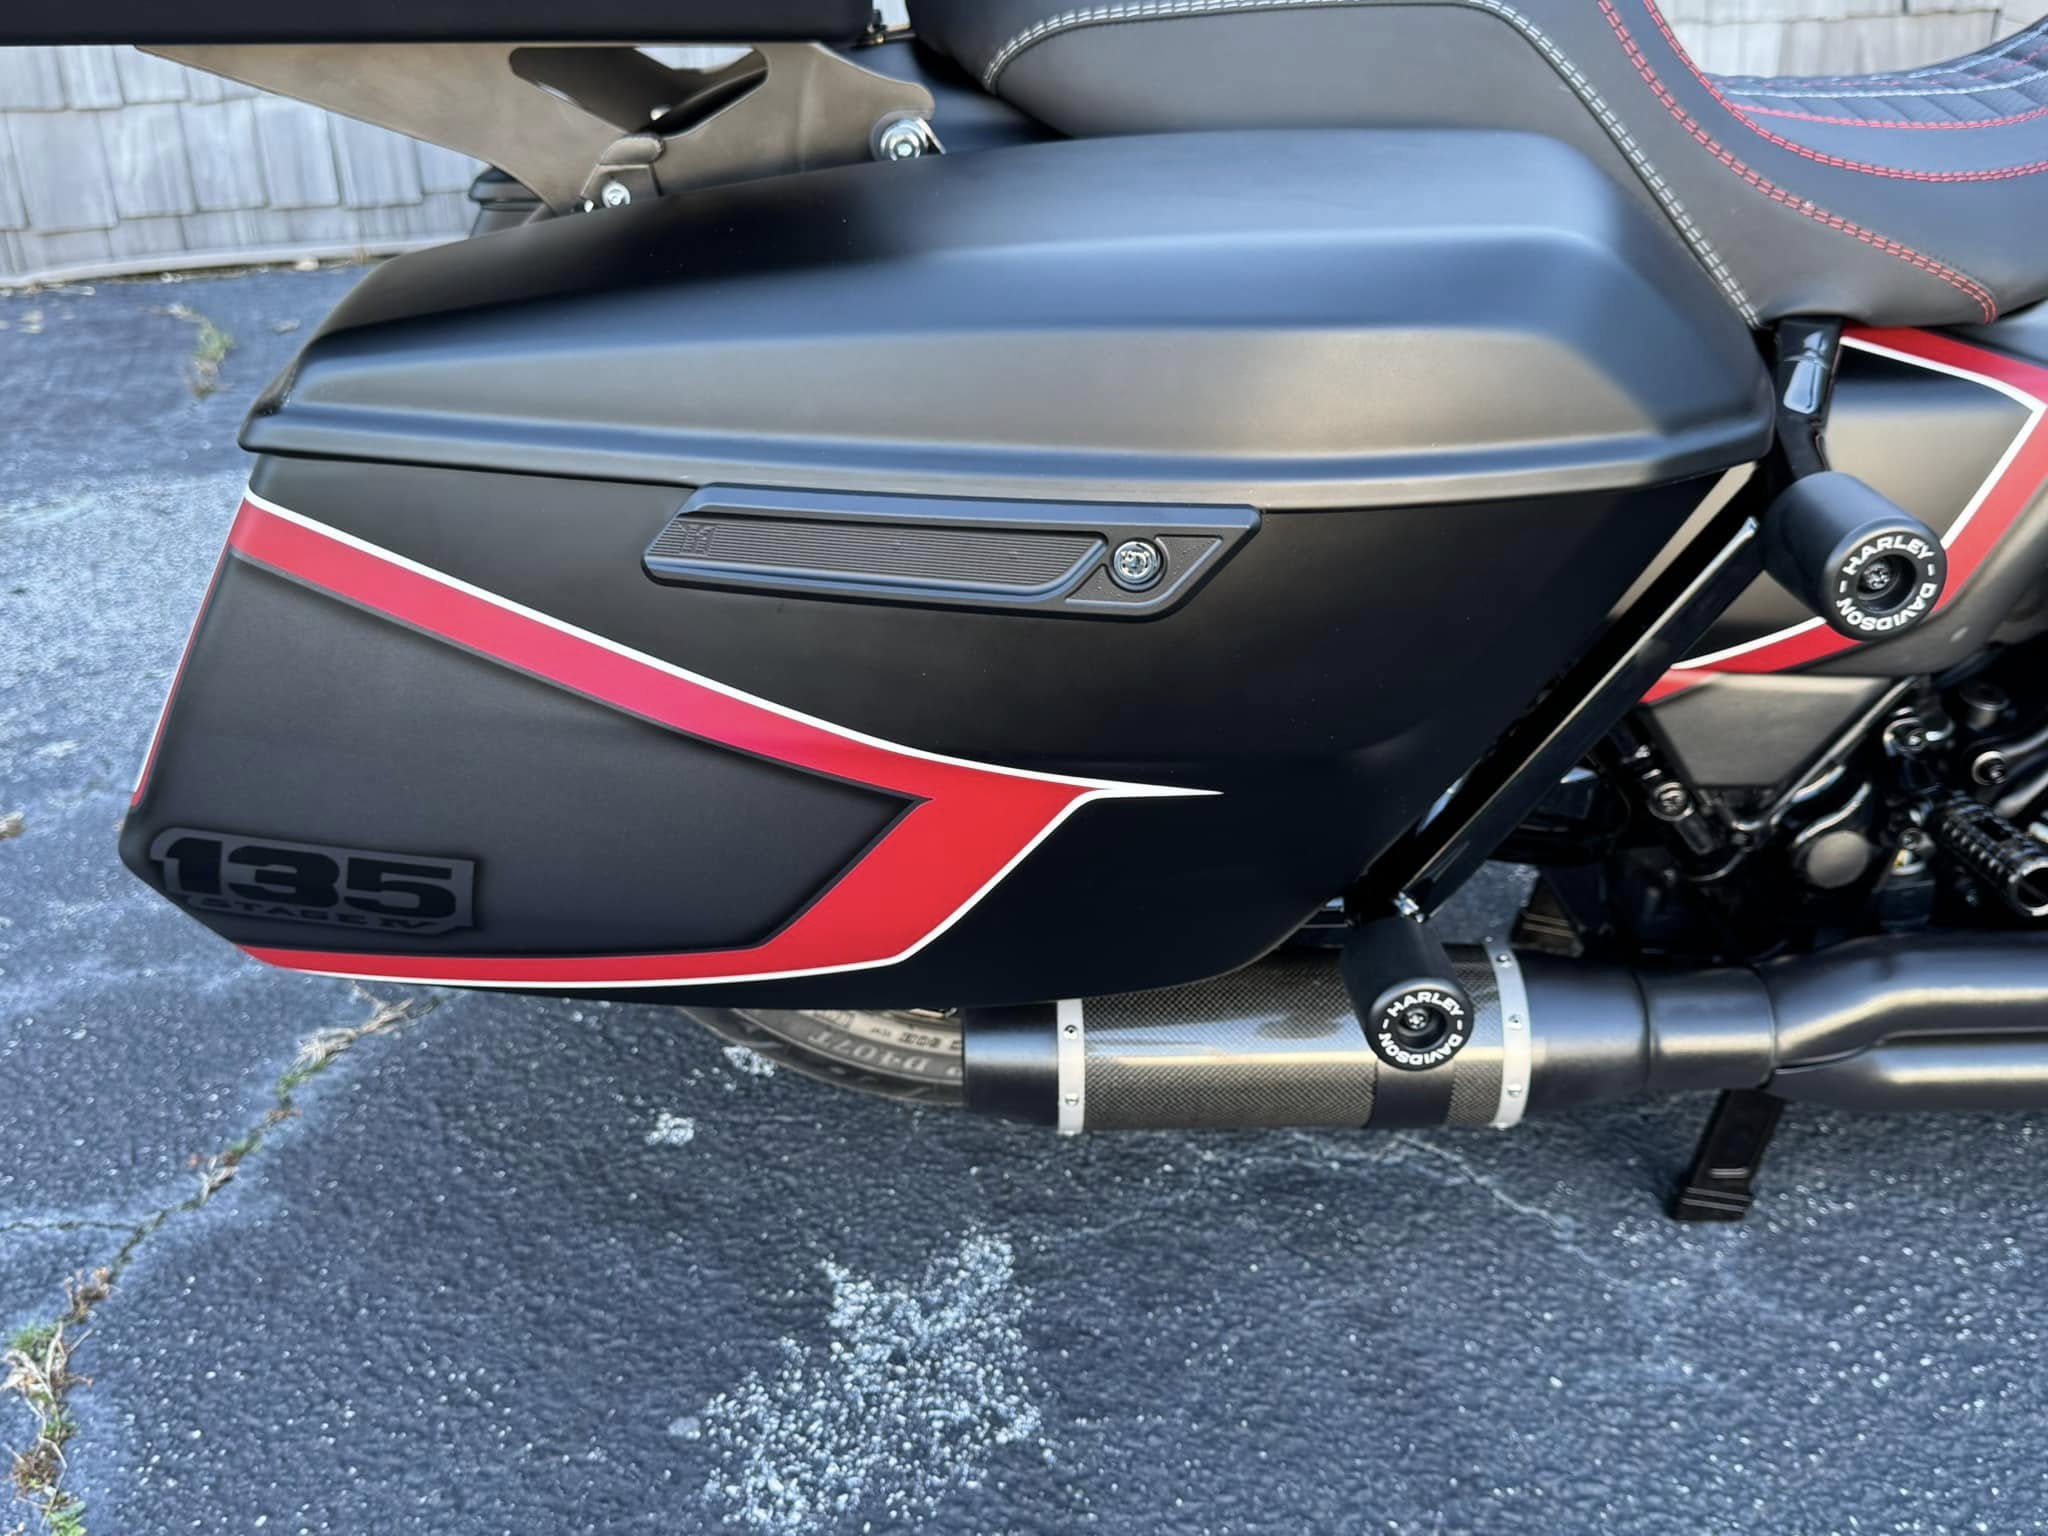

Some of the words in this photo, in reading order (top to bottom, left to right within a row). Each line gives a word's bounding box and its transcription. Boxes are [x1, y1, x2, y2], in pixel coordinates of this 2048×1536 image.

[1842, 535, 1935, 575] HARLEY
[1836, 582, 1937, 631] DAVIDSON
[165, 836, 457, 919] 135
[200, 896, 368, 925] STAGE
[1386, 991, 1464, 1017] HARLEY
[1378, 1032, 1463, 1065] DAVIDSON
